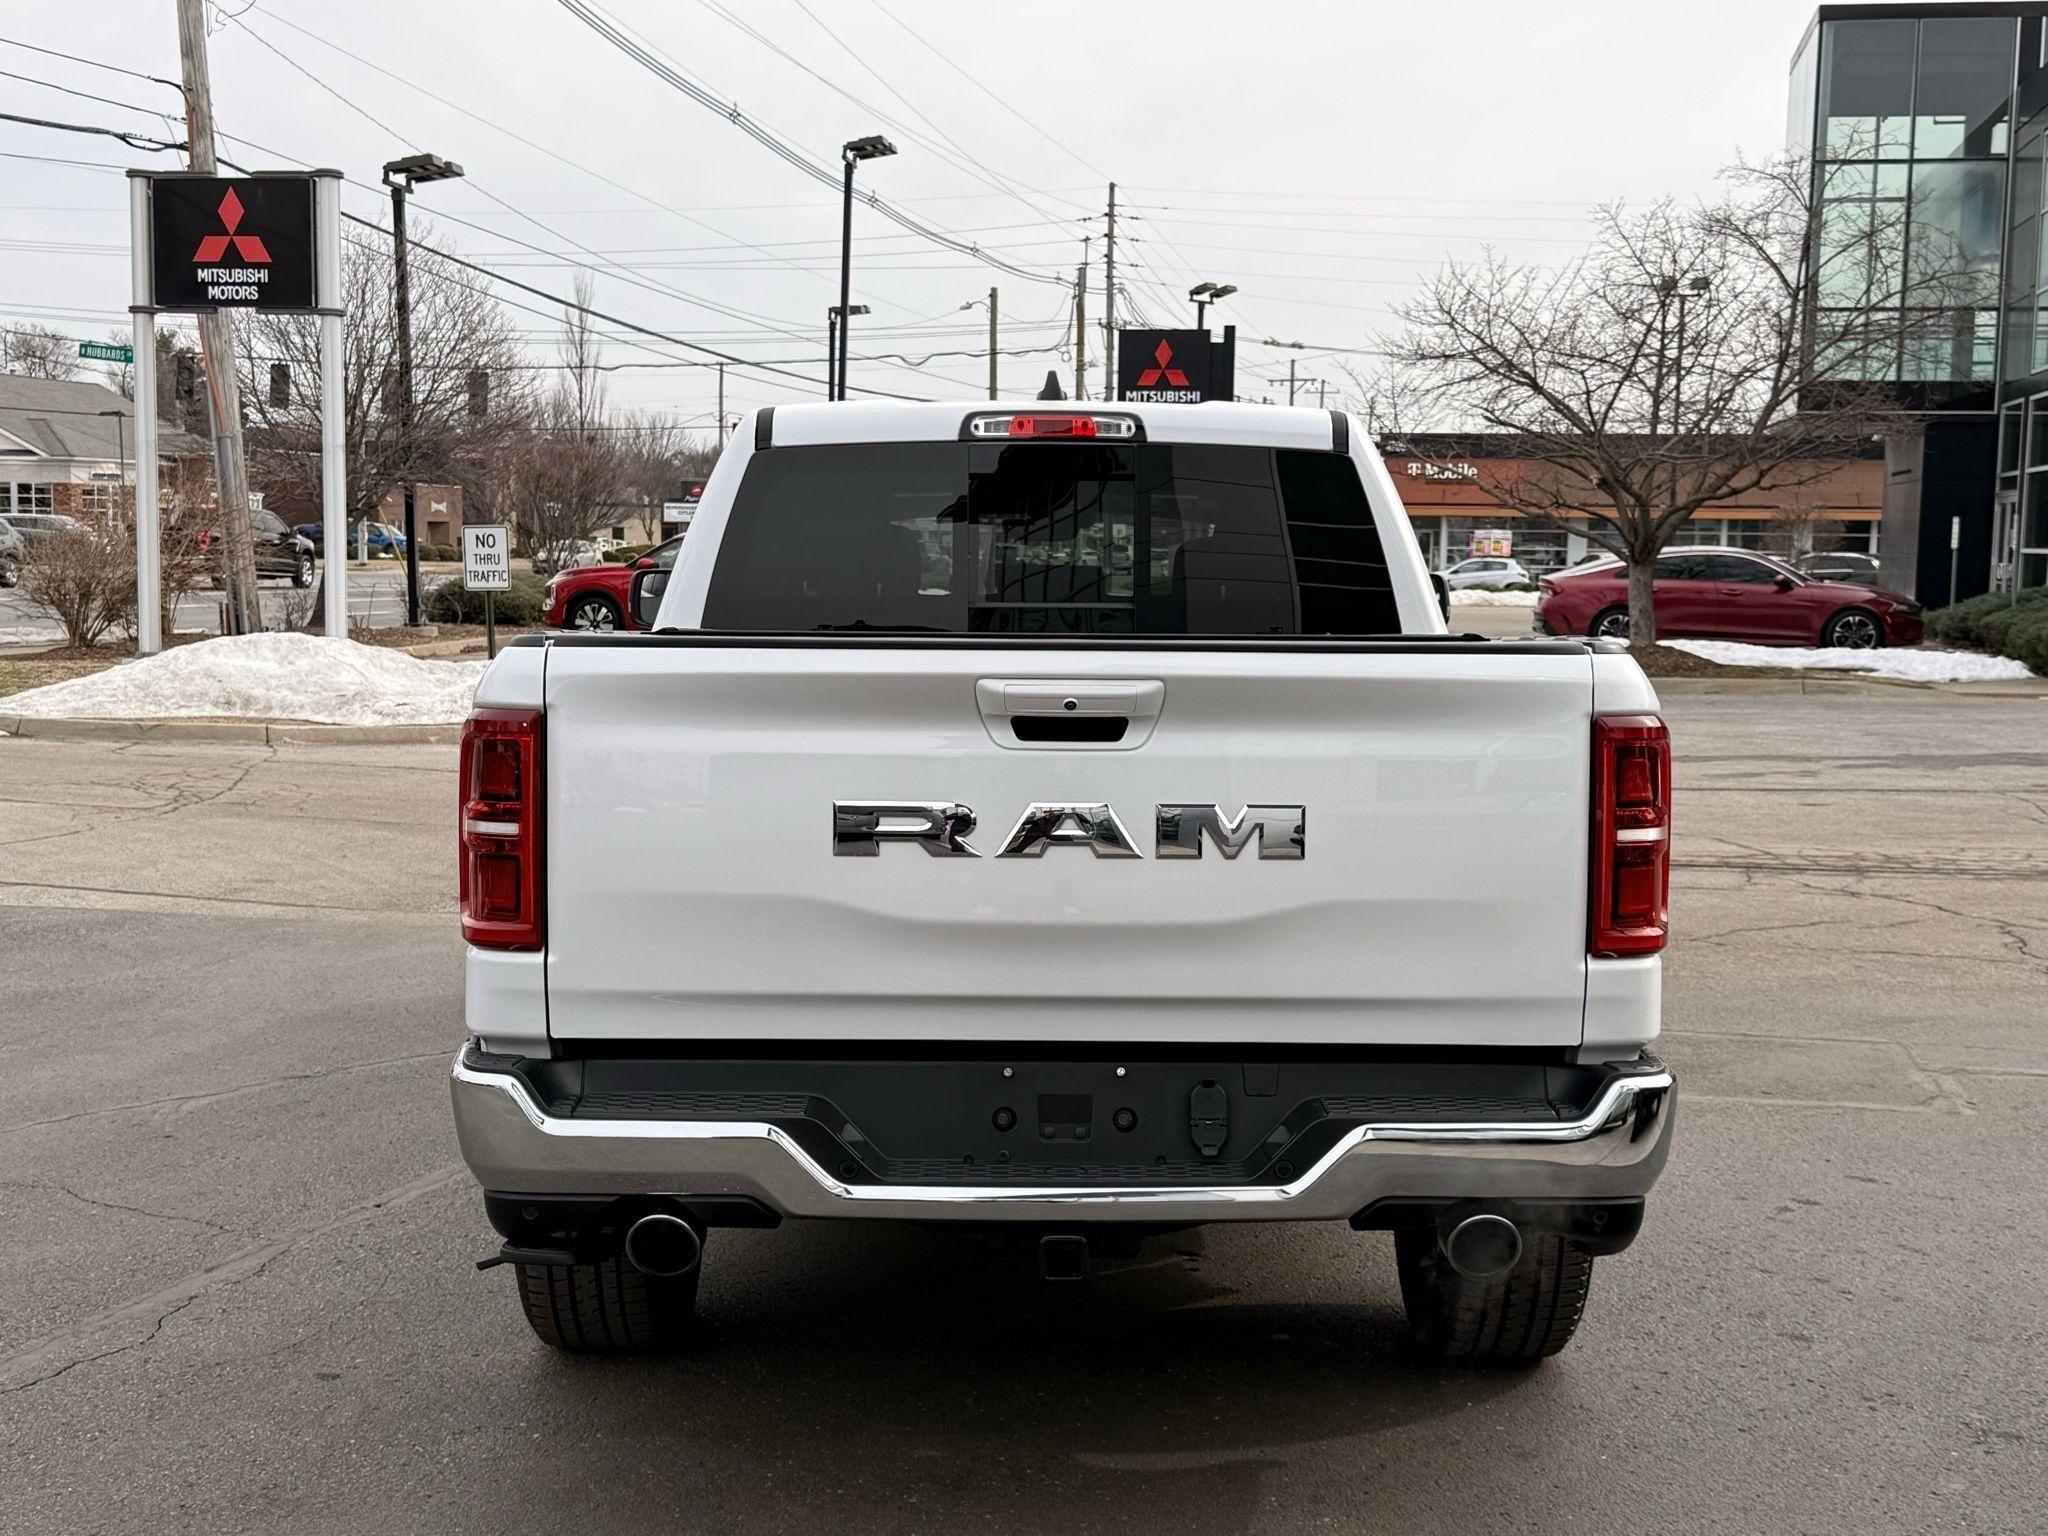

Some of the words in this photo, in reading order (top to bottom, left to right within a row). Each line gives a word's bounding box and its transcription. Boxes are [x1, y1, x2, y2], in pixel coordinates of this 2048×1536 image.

[197, 268, 269, 283] MITSUBISHI
[207, 285, 259, 300] MOTORS
[86, 346, 126, 360] HUBBARDS
[1125, 390, 1201, 402] MITSUBISHI
[475, 533, 496, 548] NO
[473, 553, 501, 565] THRU
[468, 570, 508, 582] TRAFFIC
[832, 800, 1306, 860] RAM
